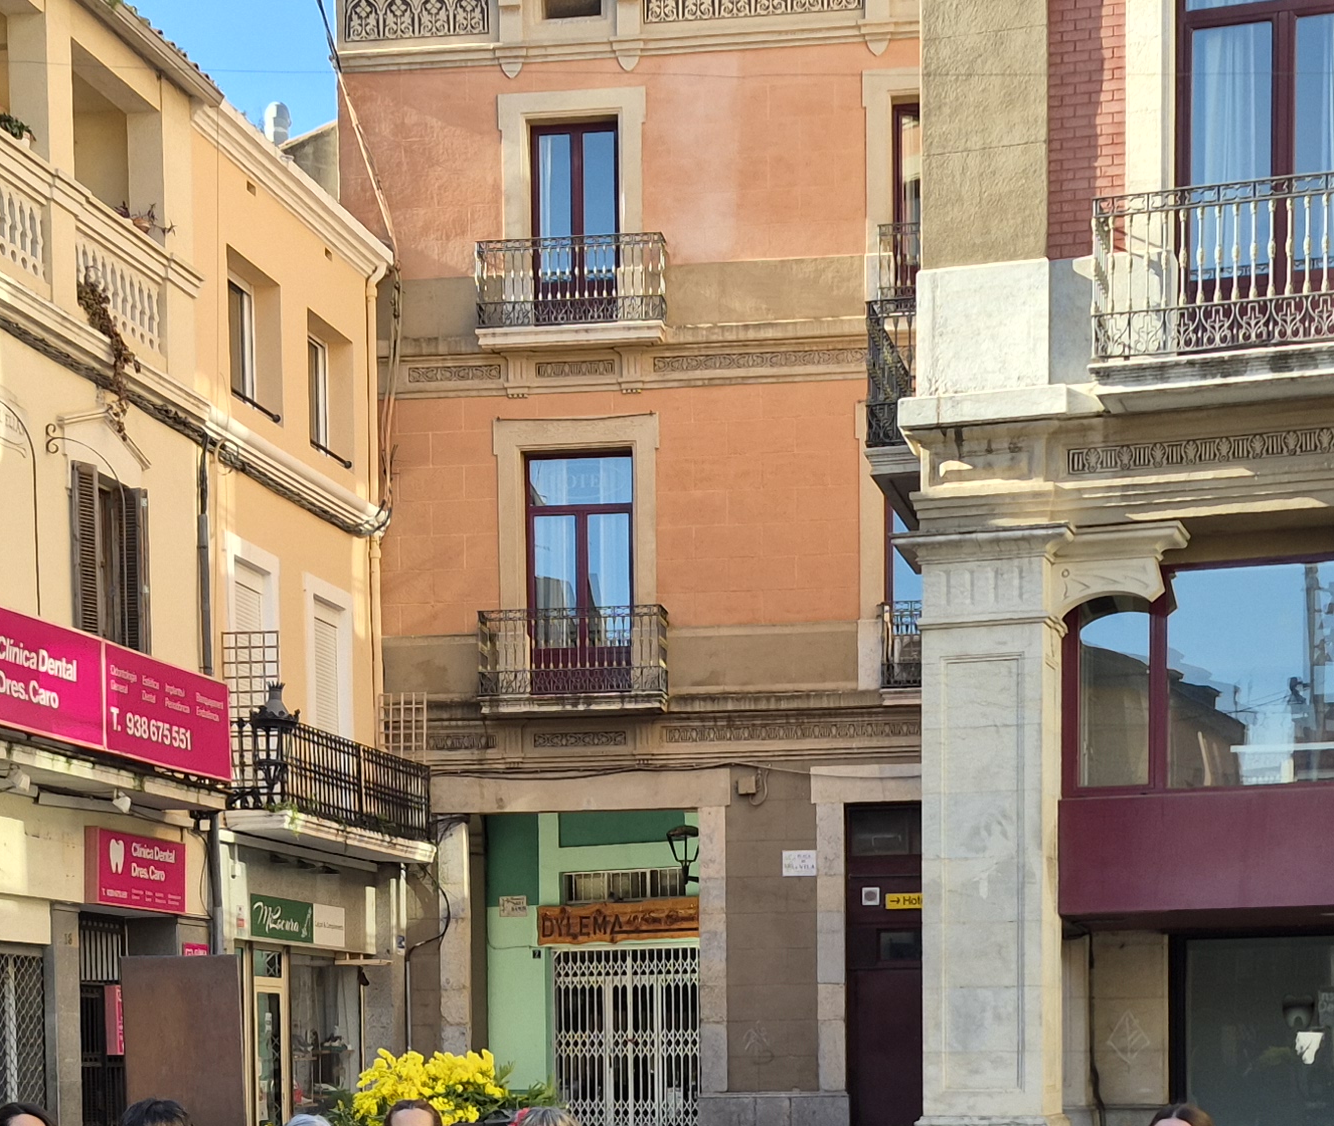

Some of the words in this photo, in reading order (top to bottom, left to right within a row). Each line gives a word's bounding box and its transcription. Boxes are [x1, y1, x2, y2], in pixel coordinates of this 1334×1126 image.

[38, 649, 77, 682] Dental
[29, 680, 59, 709] Caro
[110, 706, 121, 732] T.
[126, 712, 148, 739] 938
[150, 719, 171, 745] 675
[172, 725, 191, 750] 551
[132, 842, 153, 860] Clínica
[154, 846, 175, 864] Dental
[149, 865, 165, 881] Caro
[903, 895, 923, 906] Hot
[541, 913, 623, 938] DYLEMA
